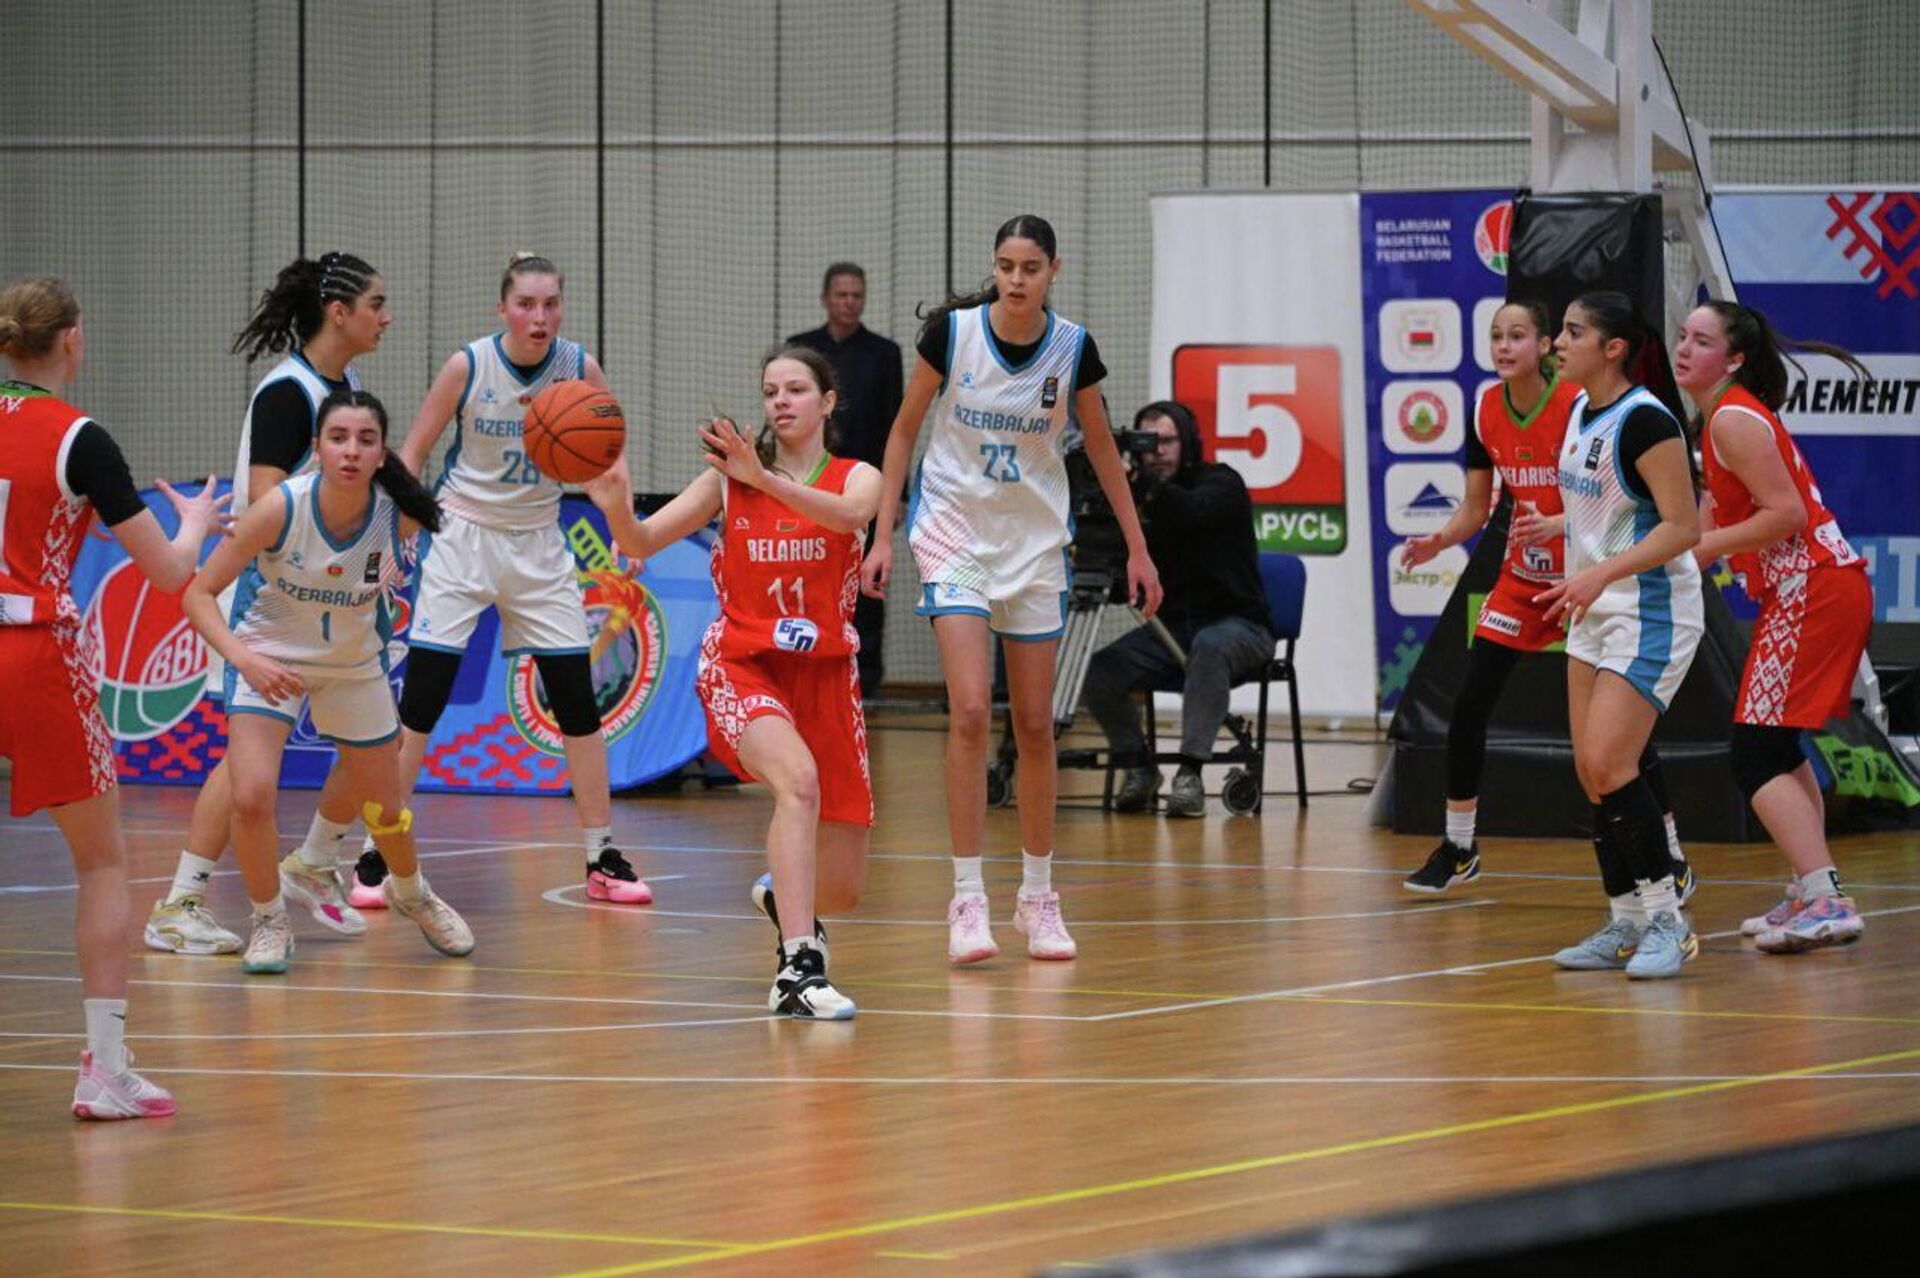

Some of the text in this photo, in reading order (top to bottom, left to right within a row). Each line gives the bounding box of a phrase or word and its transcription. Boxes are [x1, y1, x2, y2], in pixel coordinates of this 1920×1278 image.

[1376, 220, 1451, 233] BELARUSIAN
[1376, 235, 1450, 247] BASKETBALL
[1376, 250, 1451, 263] FEDERATION
[1215, 364, 1302, 489] 5
[500, 450, 540, 485] 28
[979, 443, 1021, 482] 23
[747, 537, 827, 562] BELARUS
[767, 576, 805, 616] 11
[320, 611, 331, 642] 1
